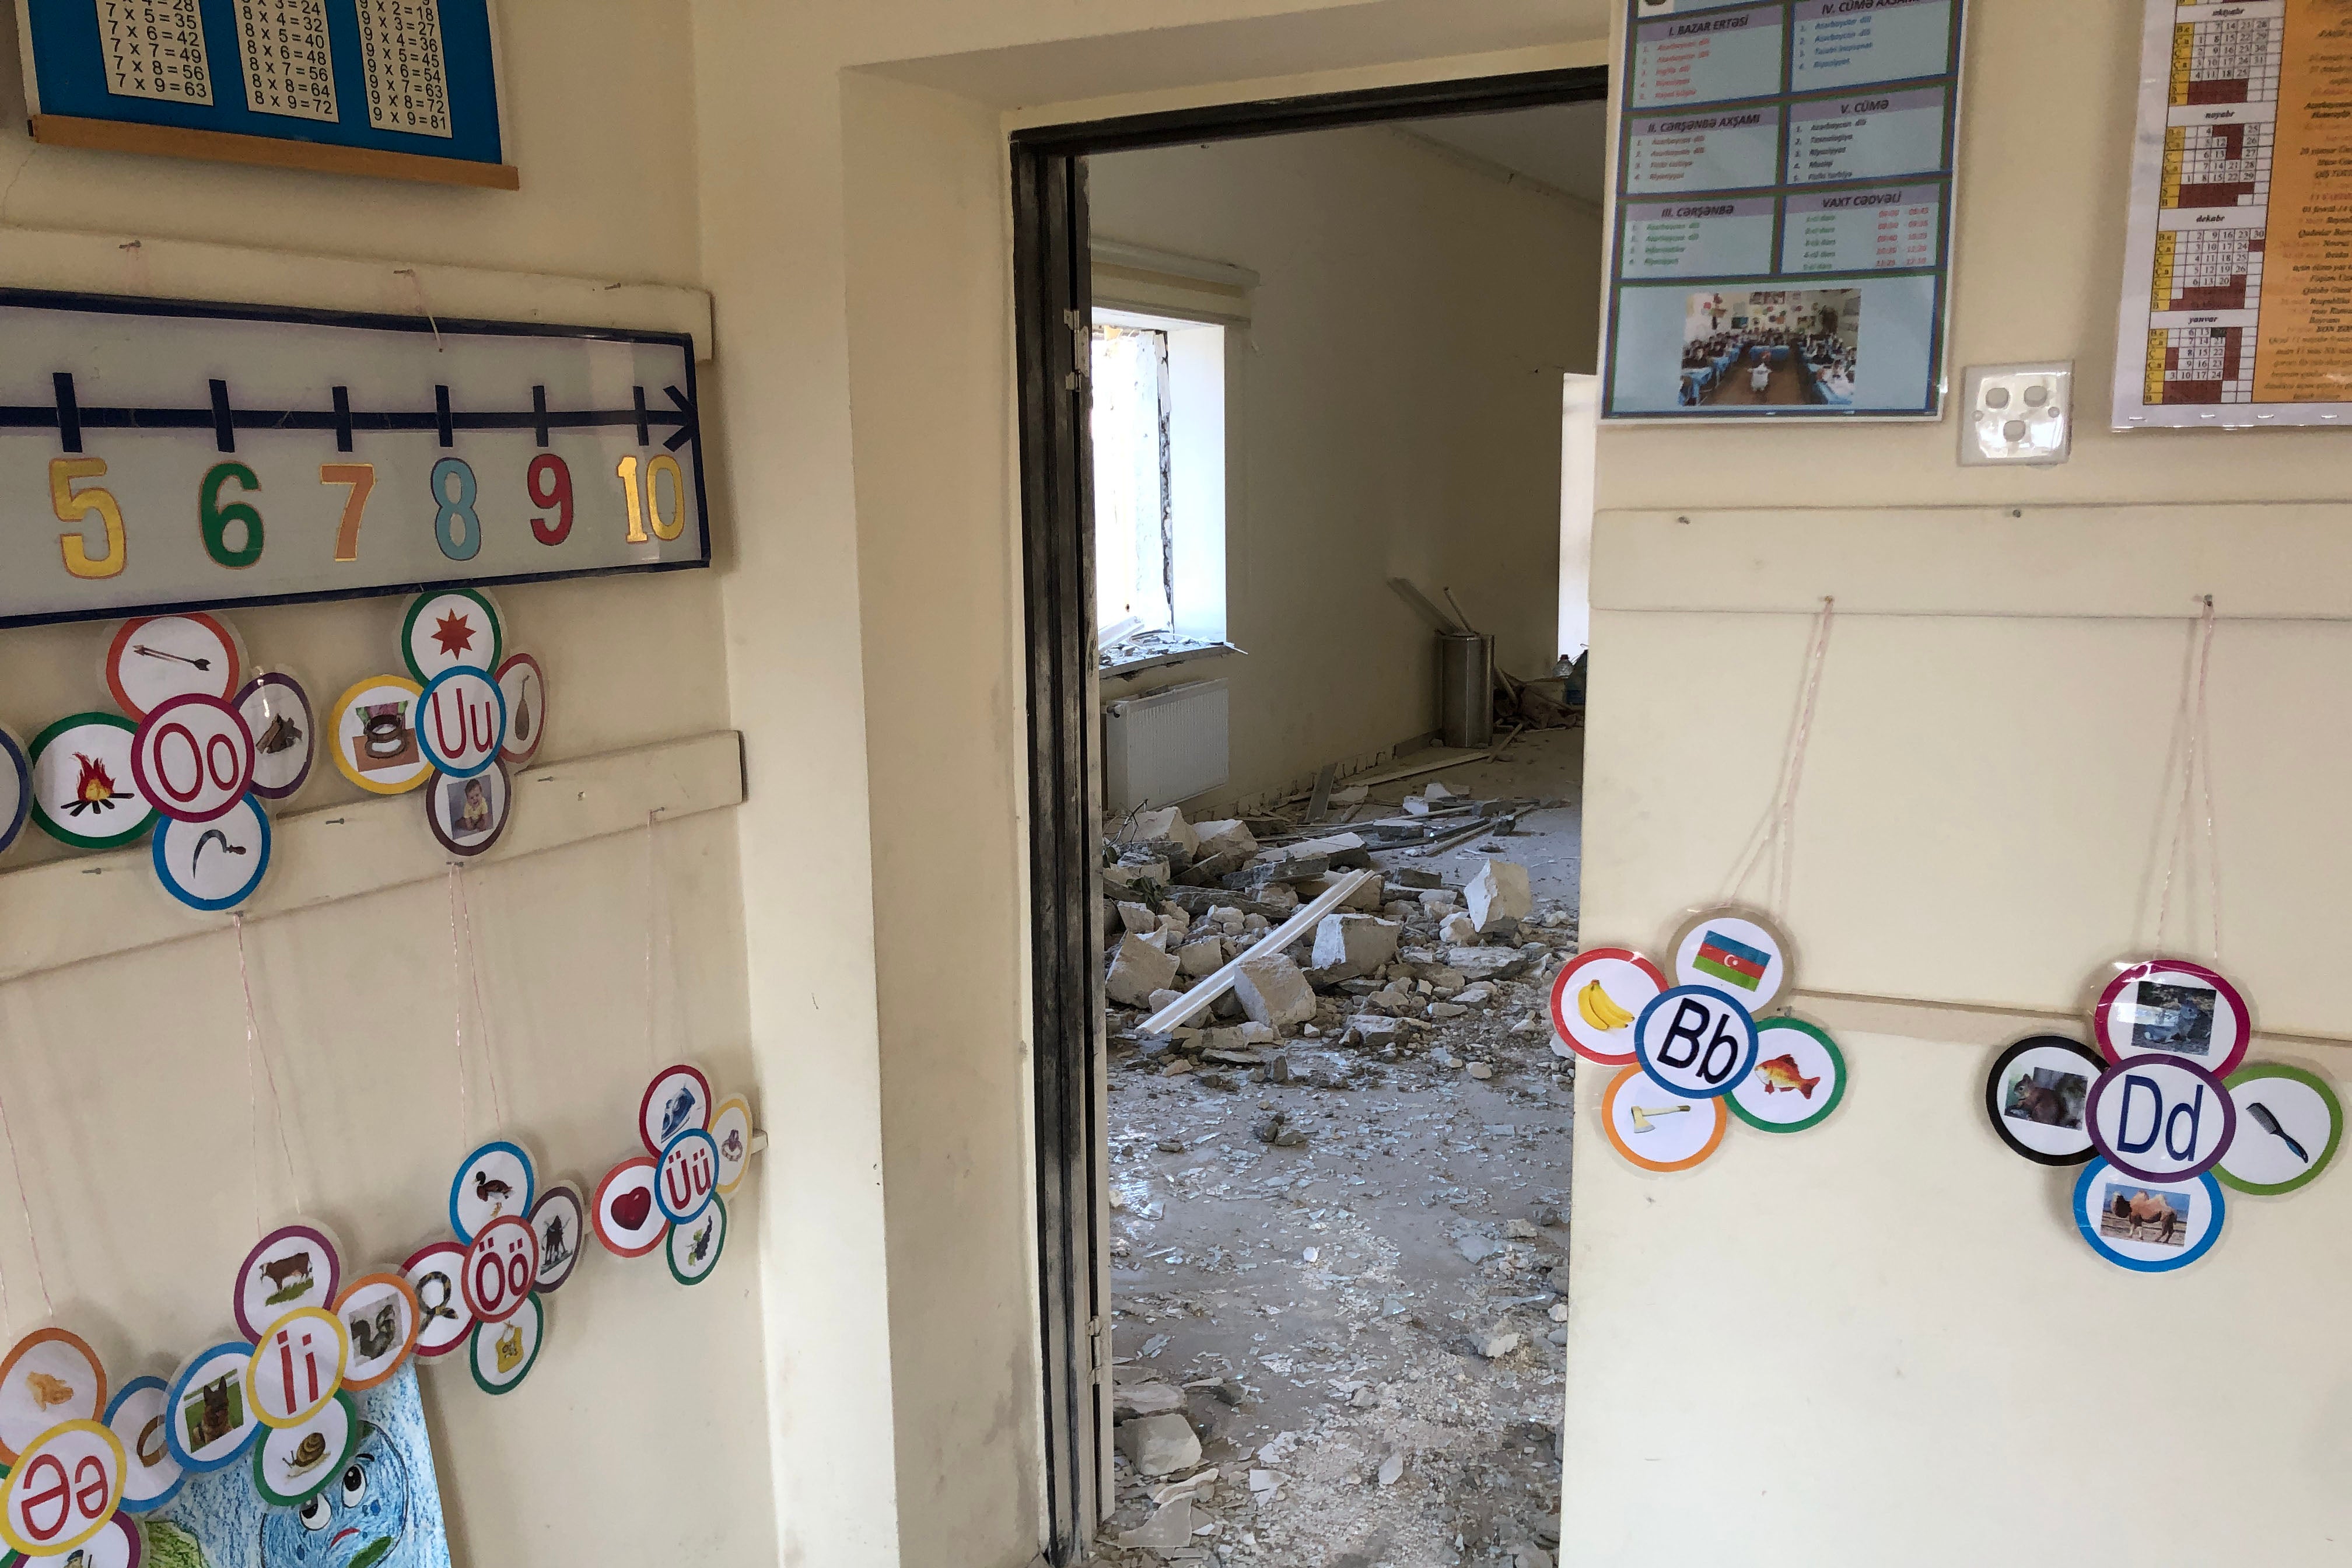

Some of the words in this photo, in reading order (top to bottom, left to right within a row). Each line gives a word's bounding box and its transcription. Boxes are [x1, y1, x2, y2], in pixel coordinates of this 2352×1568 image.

[1677, 22, 1711, 35] BAZAR
[2205, 110, 2235, 120] noyabr
[1822, 196, 1853, 208] VAXT
[49, 457, 127, 580] 5
[198, 460, 265, 570] 6
[320, 463, 376, 562] 7
[430, 457, 481, 561] 8
[527, 453, 574, 546] 9
[617, 454, 685, 544] 10
[153, 722, 239, 802] Oo
[432, 688, 495, 760] Uu
[1657, 997, 1743, 1086] Bb
[2115, 1075, 2204, 1164] Dd
[663, 1149, 713, 1211] Üü
[475, 1237, 528, 1313] Öö
[279, 1331, 320, 1415] İi
[20, 1453, 110, 1541] Əə
